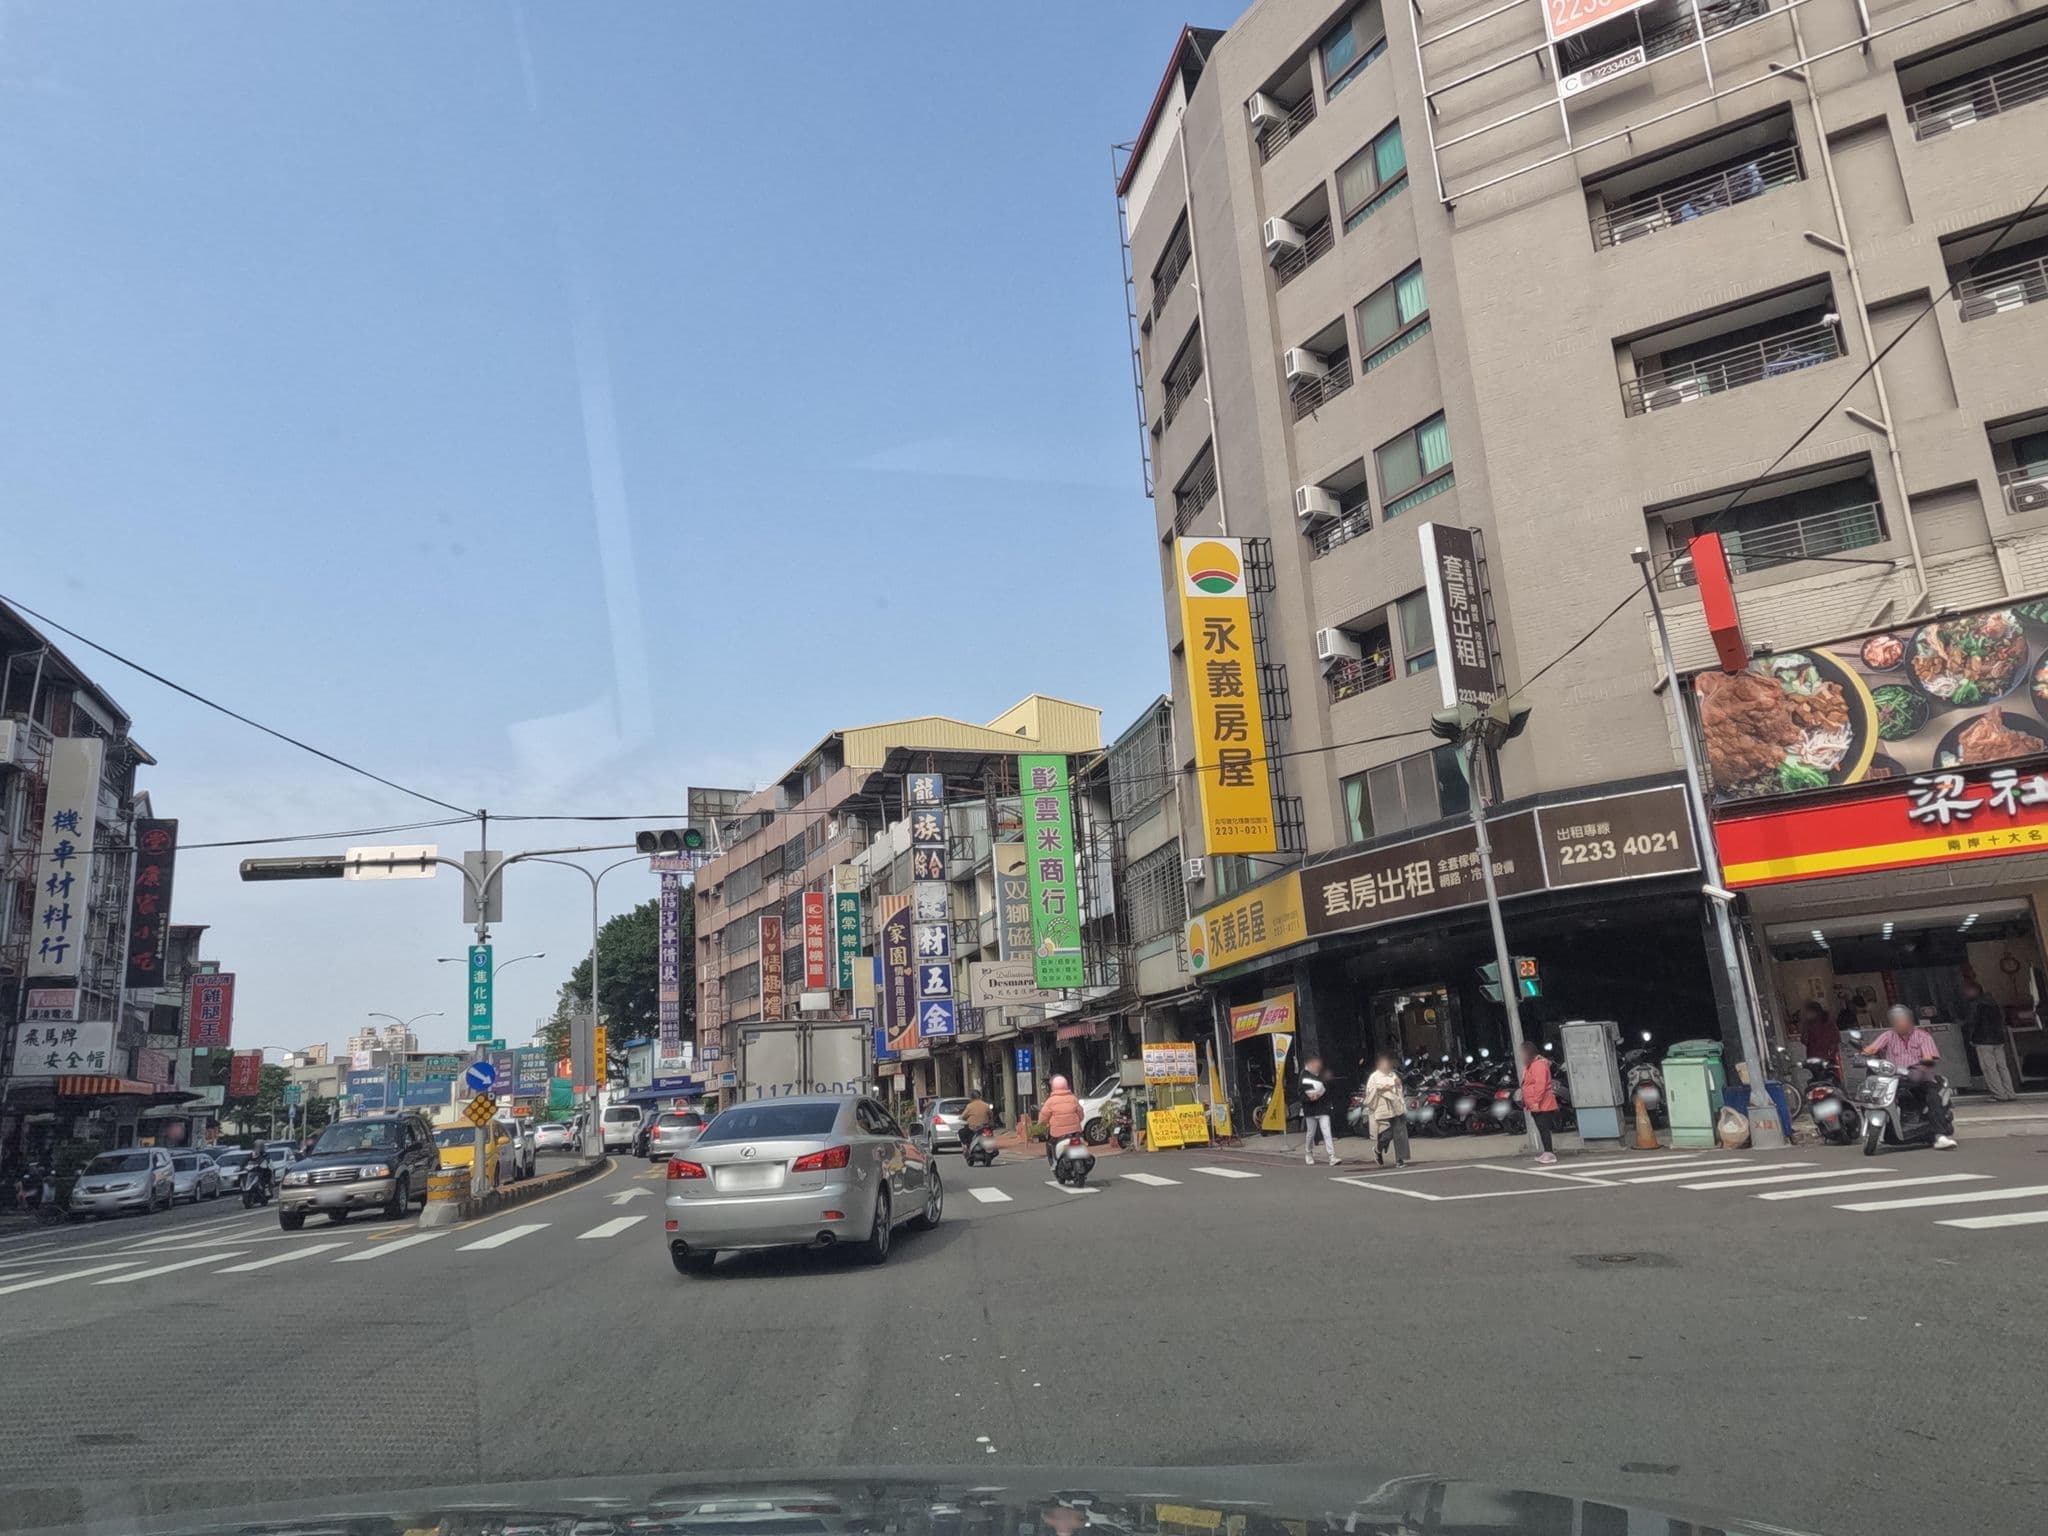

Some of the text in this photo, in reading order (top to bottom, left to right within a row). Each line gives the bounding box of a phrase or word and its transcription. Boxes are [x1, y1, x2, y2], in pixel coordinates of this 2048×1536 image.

[1443, 554, 1478, 667] 套房出租
[1203, 617, 1254, 787] 永義房屋
[1031, 766, 1067, 915] 彰雲米商行
[1215, 825, 1268, 836] 2231-0211
[1559, 831, 1679, 865] 2233 4021
[38, 808, 82, 964] 機車材料行
[1322, 859, 1435, 917] 套房出租
[1209, 900, 1266, 957] 永義房屋
[473, 970, 487, 1016] 進化路
[1520, 960, 1536, 976] 23
[23, 1028, 78, 1047] 飛馬牌
[43, 1050, 107, 1069] 安全帽
